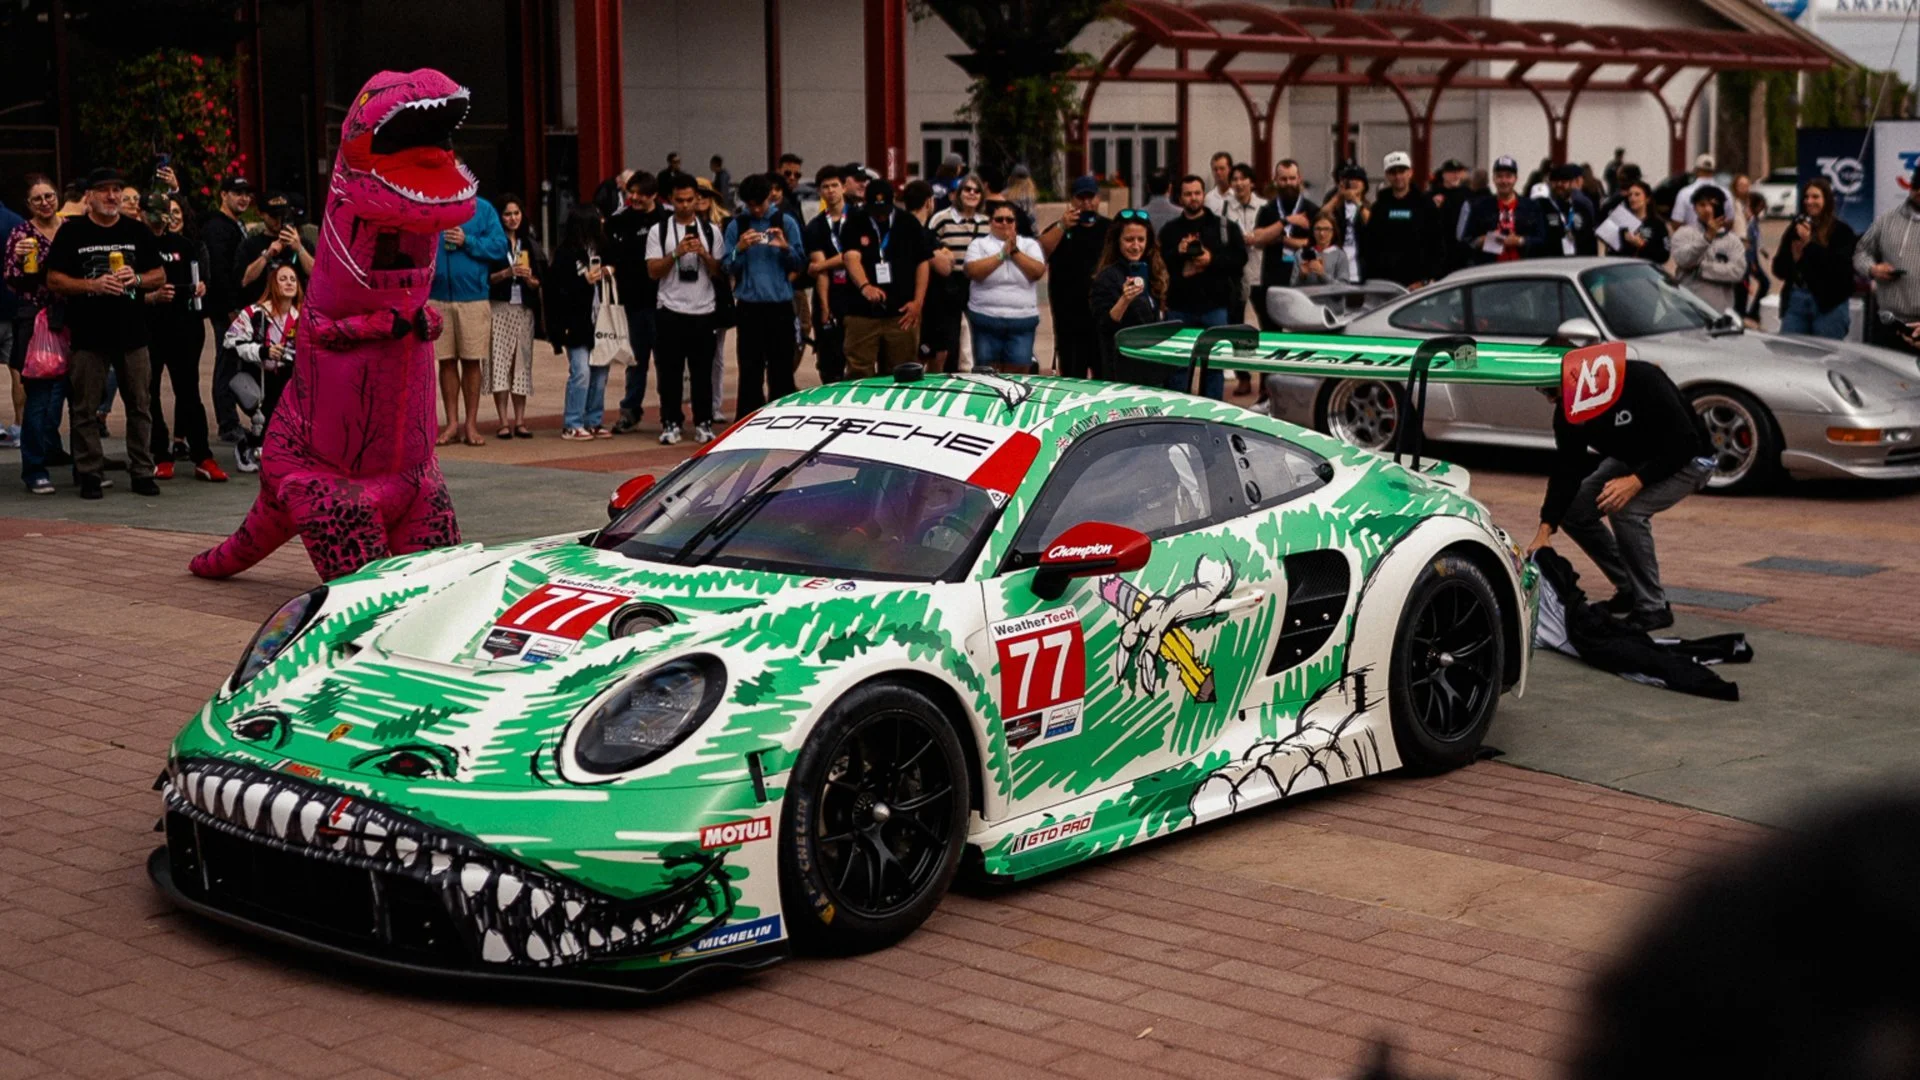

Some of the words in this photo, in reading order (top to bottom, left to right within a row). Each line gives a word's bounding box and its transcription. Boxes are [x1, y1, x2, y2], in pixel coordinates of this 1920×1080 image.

[78, 244, 136, 254] PORSCHE
[737, 415, 995, 456] PORSCHE
[1048, 543, 1113, 559] Champion
[556, 578, 637, 596] WeatherTech
[512, 587, 617, 632] 77
[994, 609, 1075, 636] WeatherTech
[1008, 629, 1073, 710] 77
[703, 820, 769, 847] MOTUL
[1027, 827, 1058, 847] GTD
[1060, 816, 1091, 836] PRO
[698, 924, 772, 949] MICHELIN
